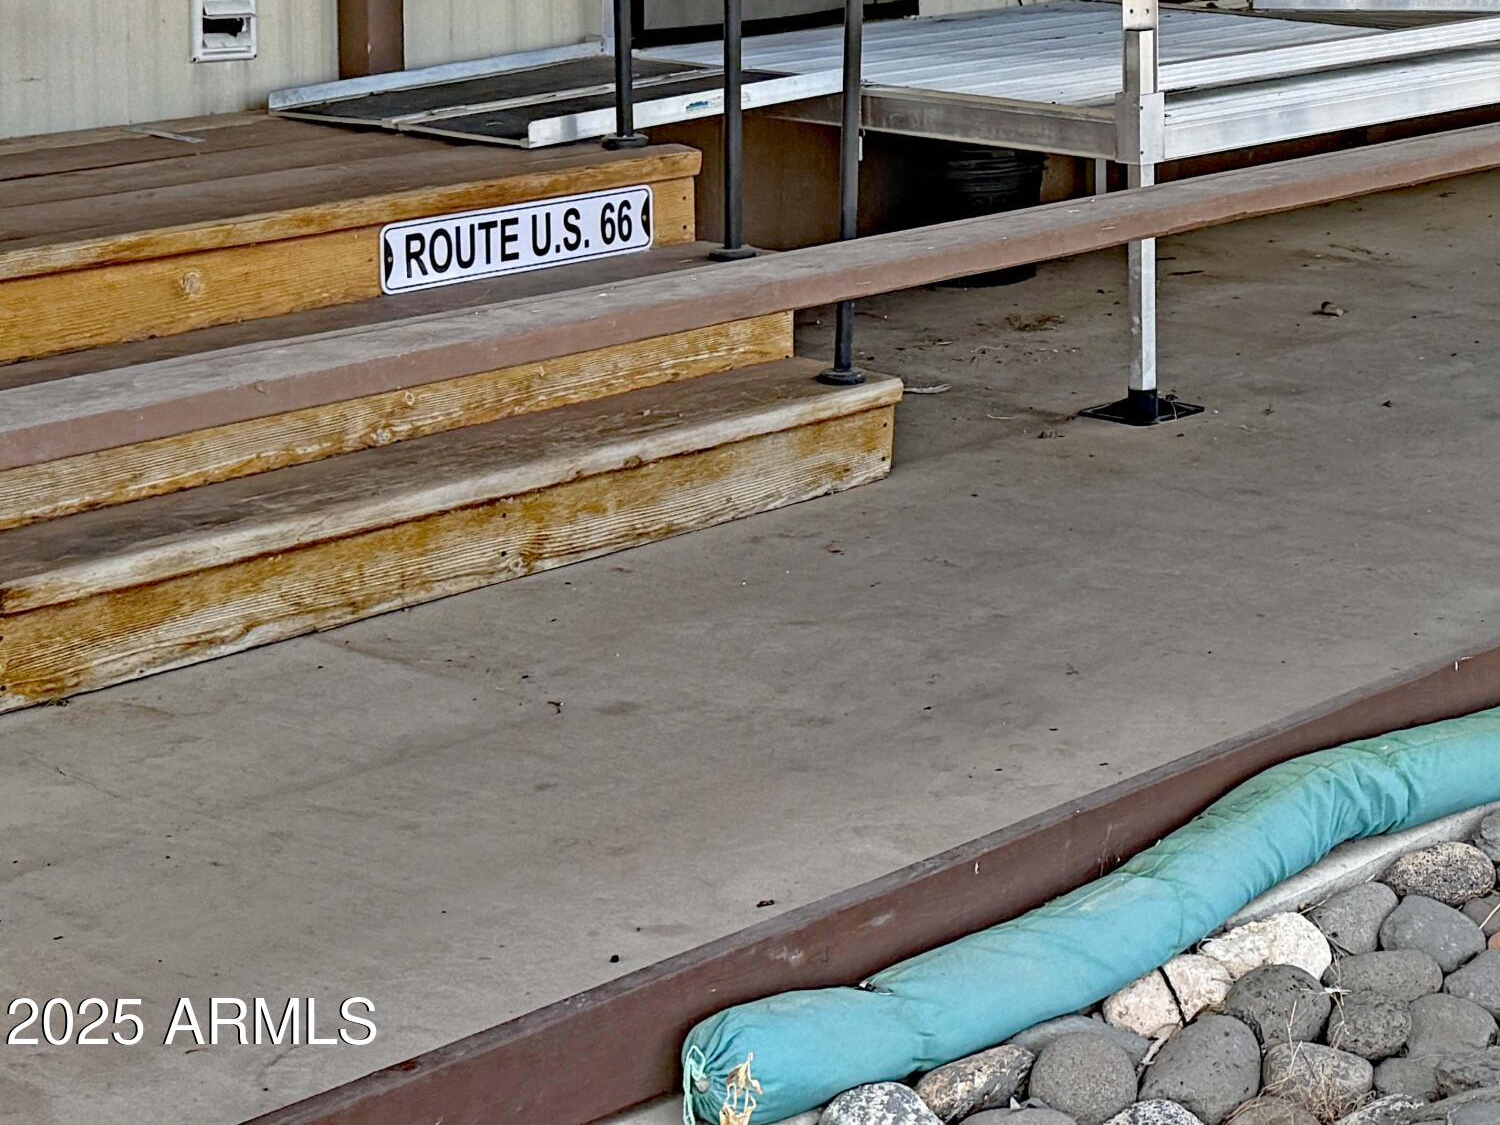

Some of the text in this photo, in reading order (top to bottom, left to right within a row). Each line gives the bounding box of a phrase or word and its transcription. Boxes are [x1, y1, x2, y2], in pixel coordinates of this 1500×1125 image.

[405, 200, 632, 278] ROUTE U.S. 66
